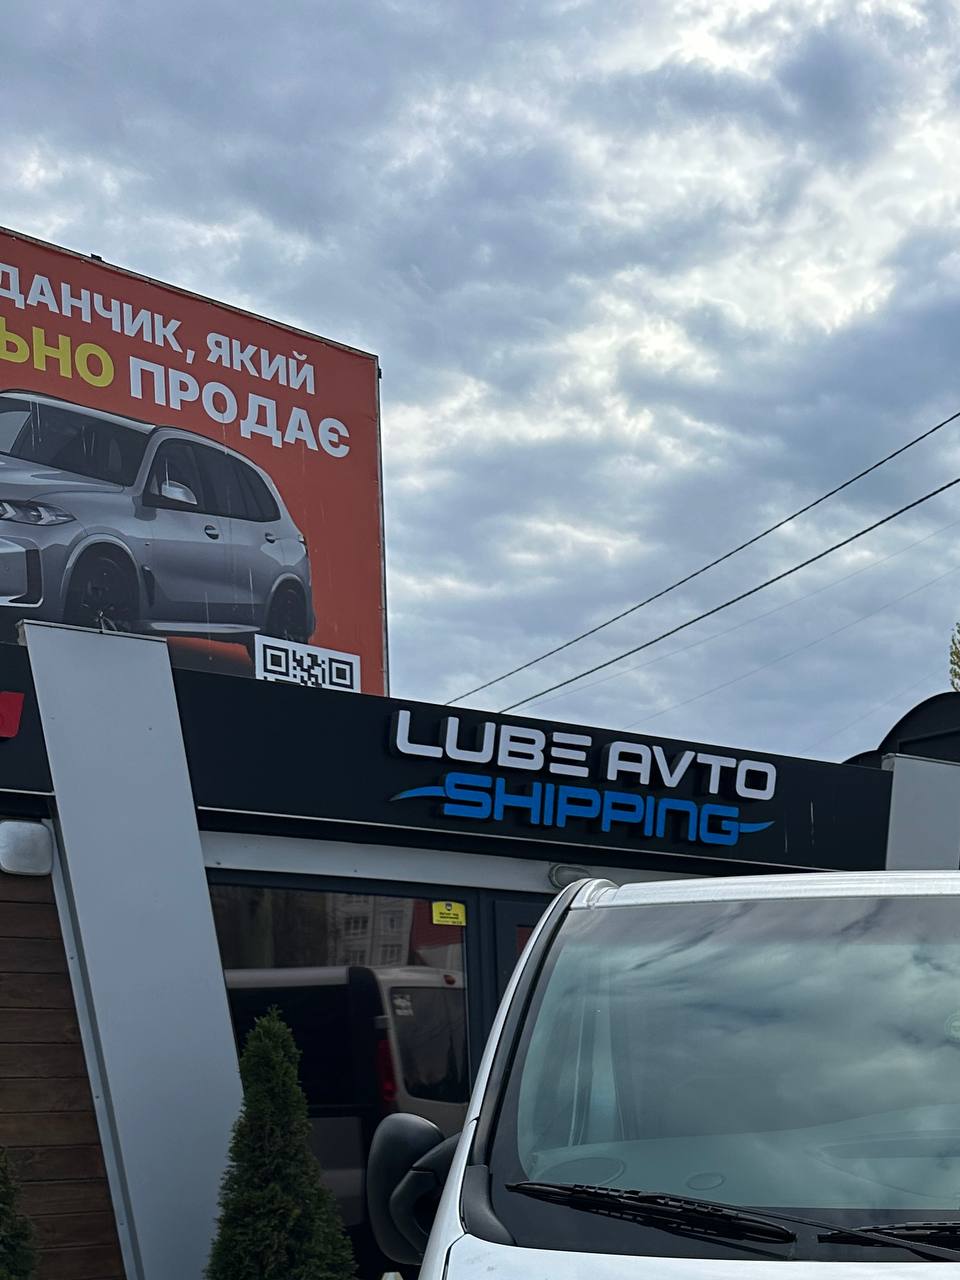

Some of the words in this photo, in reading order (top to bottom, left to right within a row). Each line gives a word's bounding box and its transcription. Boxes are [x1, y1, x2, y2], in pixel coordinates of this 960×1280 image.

[206, 332, 315, 395] ЯКИЙ
[129, 356, 350, 459] ПРОДАЄ
[396, 709, 592, 778] LUBE
[607, 741, 777, 801] AVTO
[443, 772, 740, 846] SHIPPING
